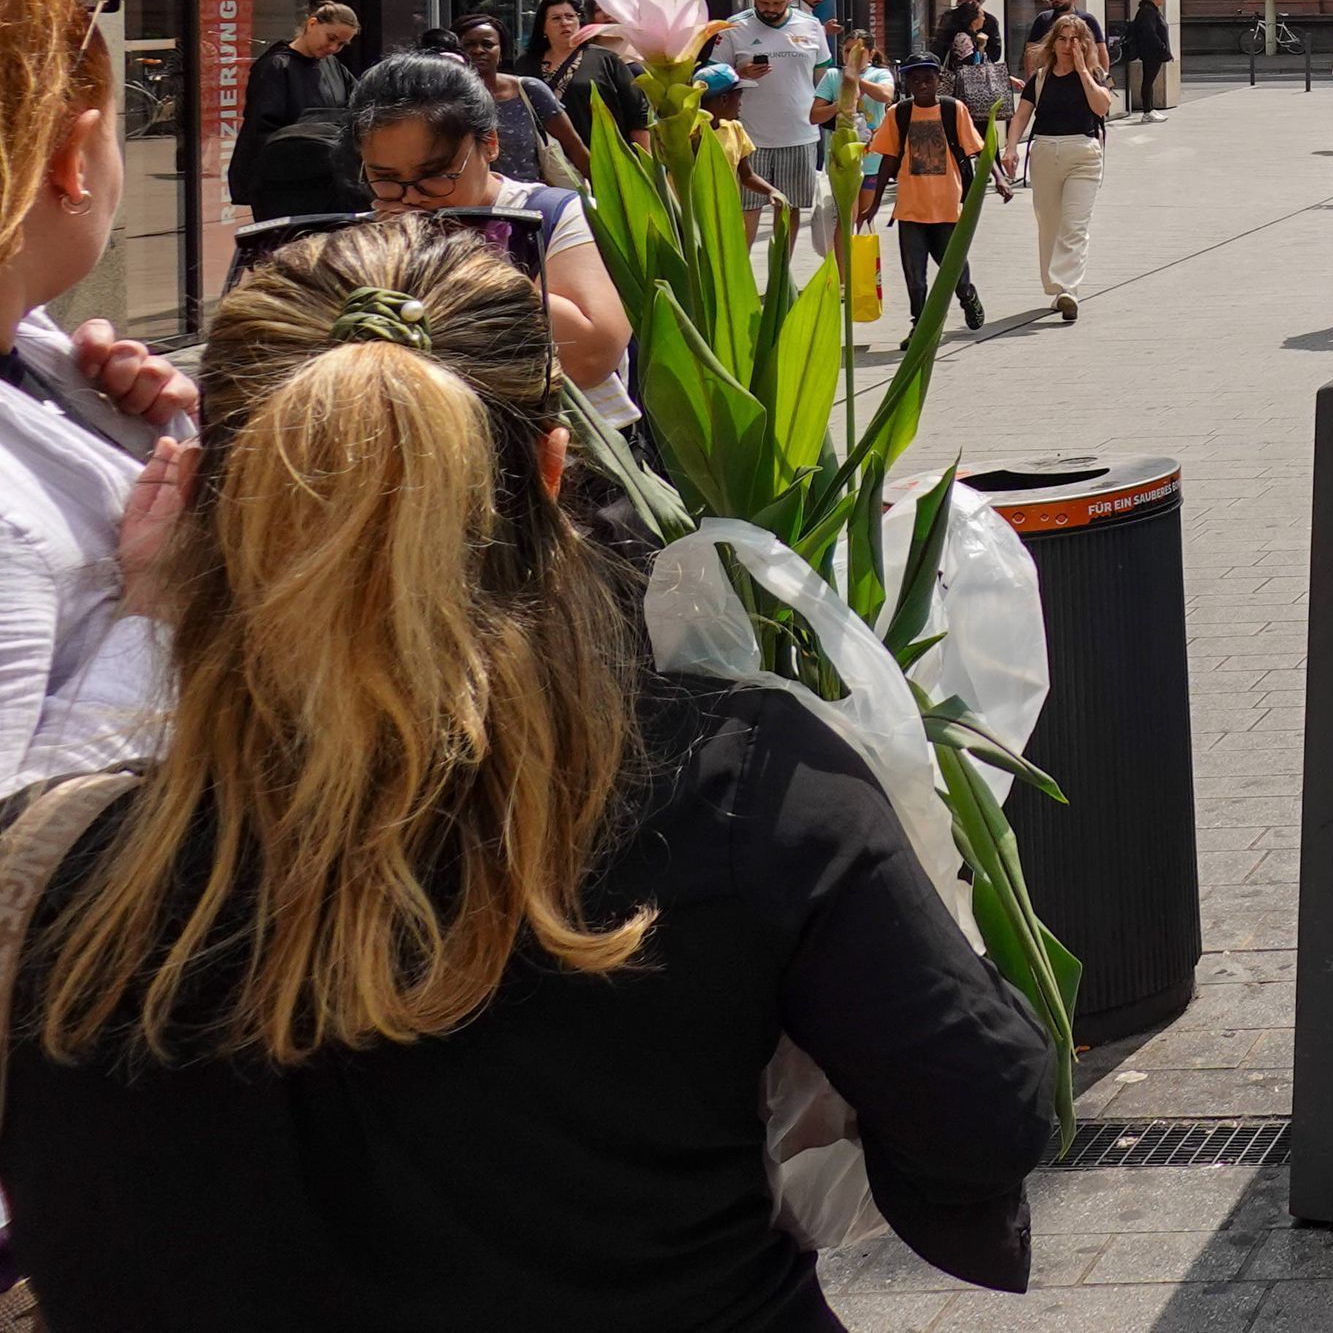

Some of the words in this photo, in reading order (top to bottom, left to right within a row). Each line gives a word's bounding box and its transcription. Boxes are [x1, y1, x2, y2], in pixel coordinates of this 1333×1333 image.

[1088, 501, 1112, 515] FÜR
[1114, 497, 1131, 510] EIN
[1133, 483, 1172, 505] SAUBERES
